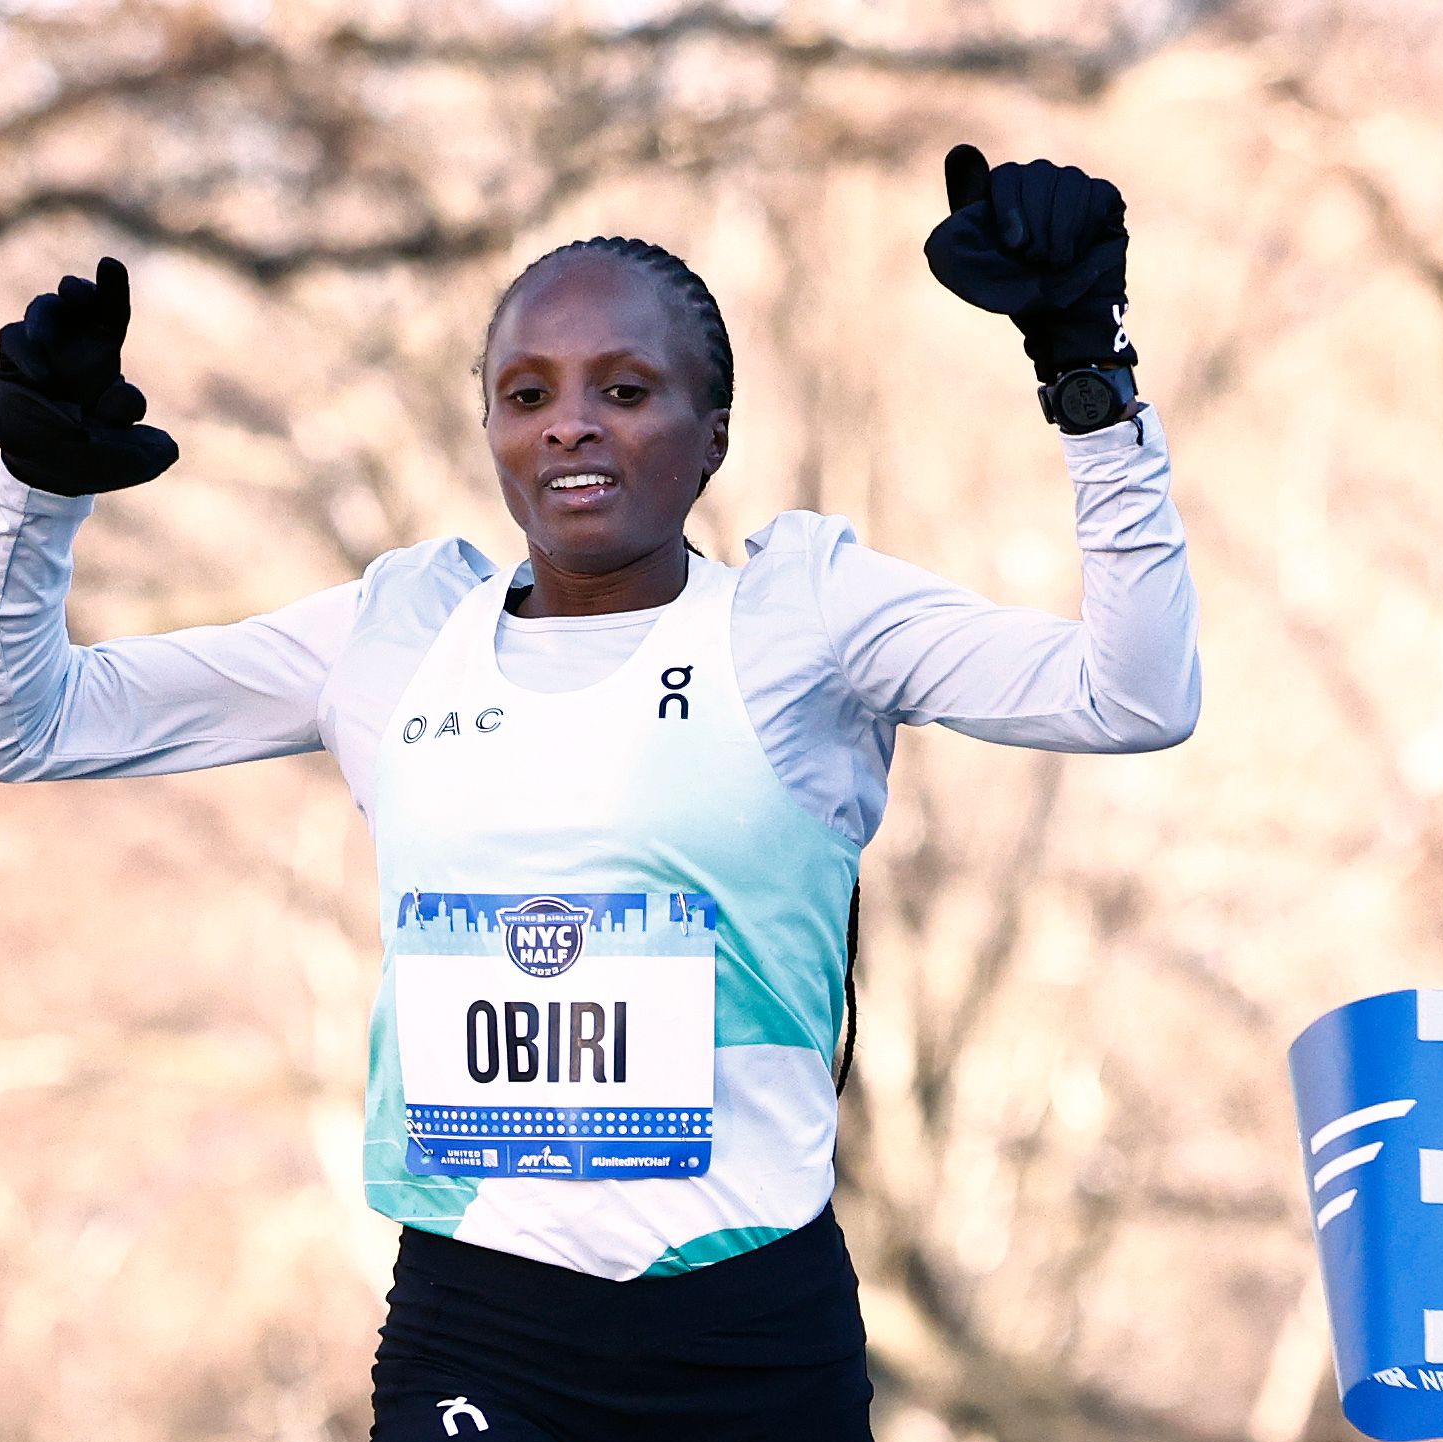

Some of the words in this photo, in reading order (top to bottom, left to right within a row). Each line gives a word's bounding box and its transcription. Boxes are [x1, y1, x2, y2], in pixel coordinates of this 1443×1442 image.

[402, 707, 504, 745] OAC
[516, 925, 572, 948] NYC
[520, 948, 569, 964] HALF
[466, 999, 627, 1084] OBIRI
[440, 1156, 482, 1166] AIRLINES
[447, 1149, 481, 1158] UNITED
[591, 1156, 671, 1168] #UnitedNYCHalf
